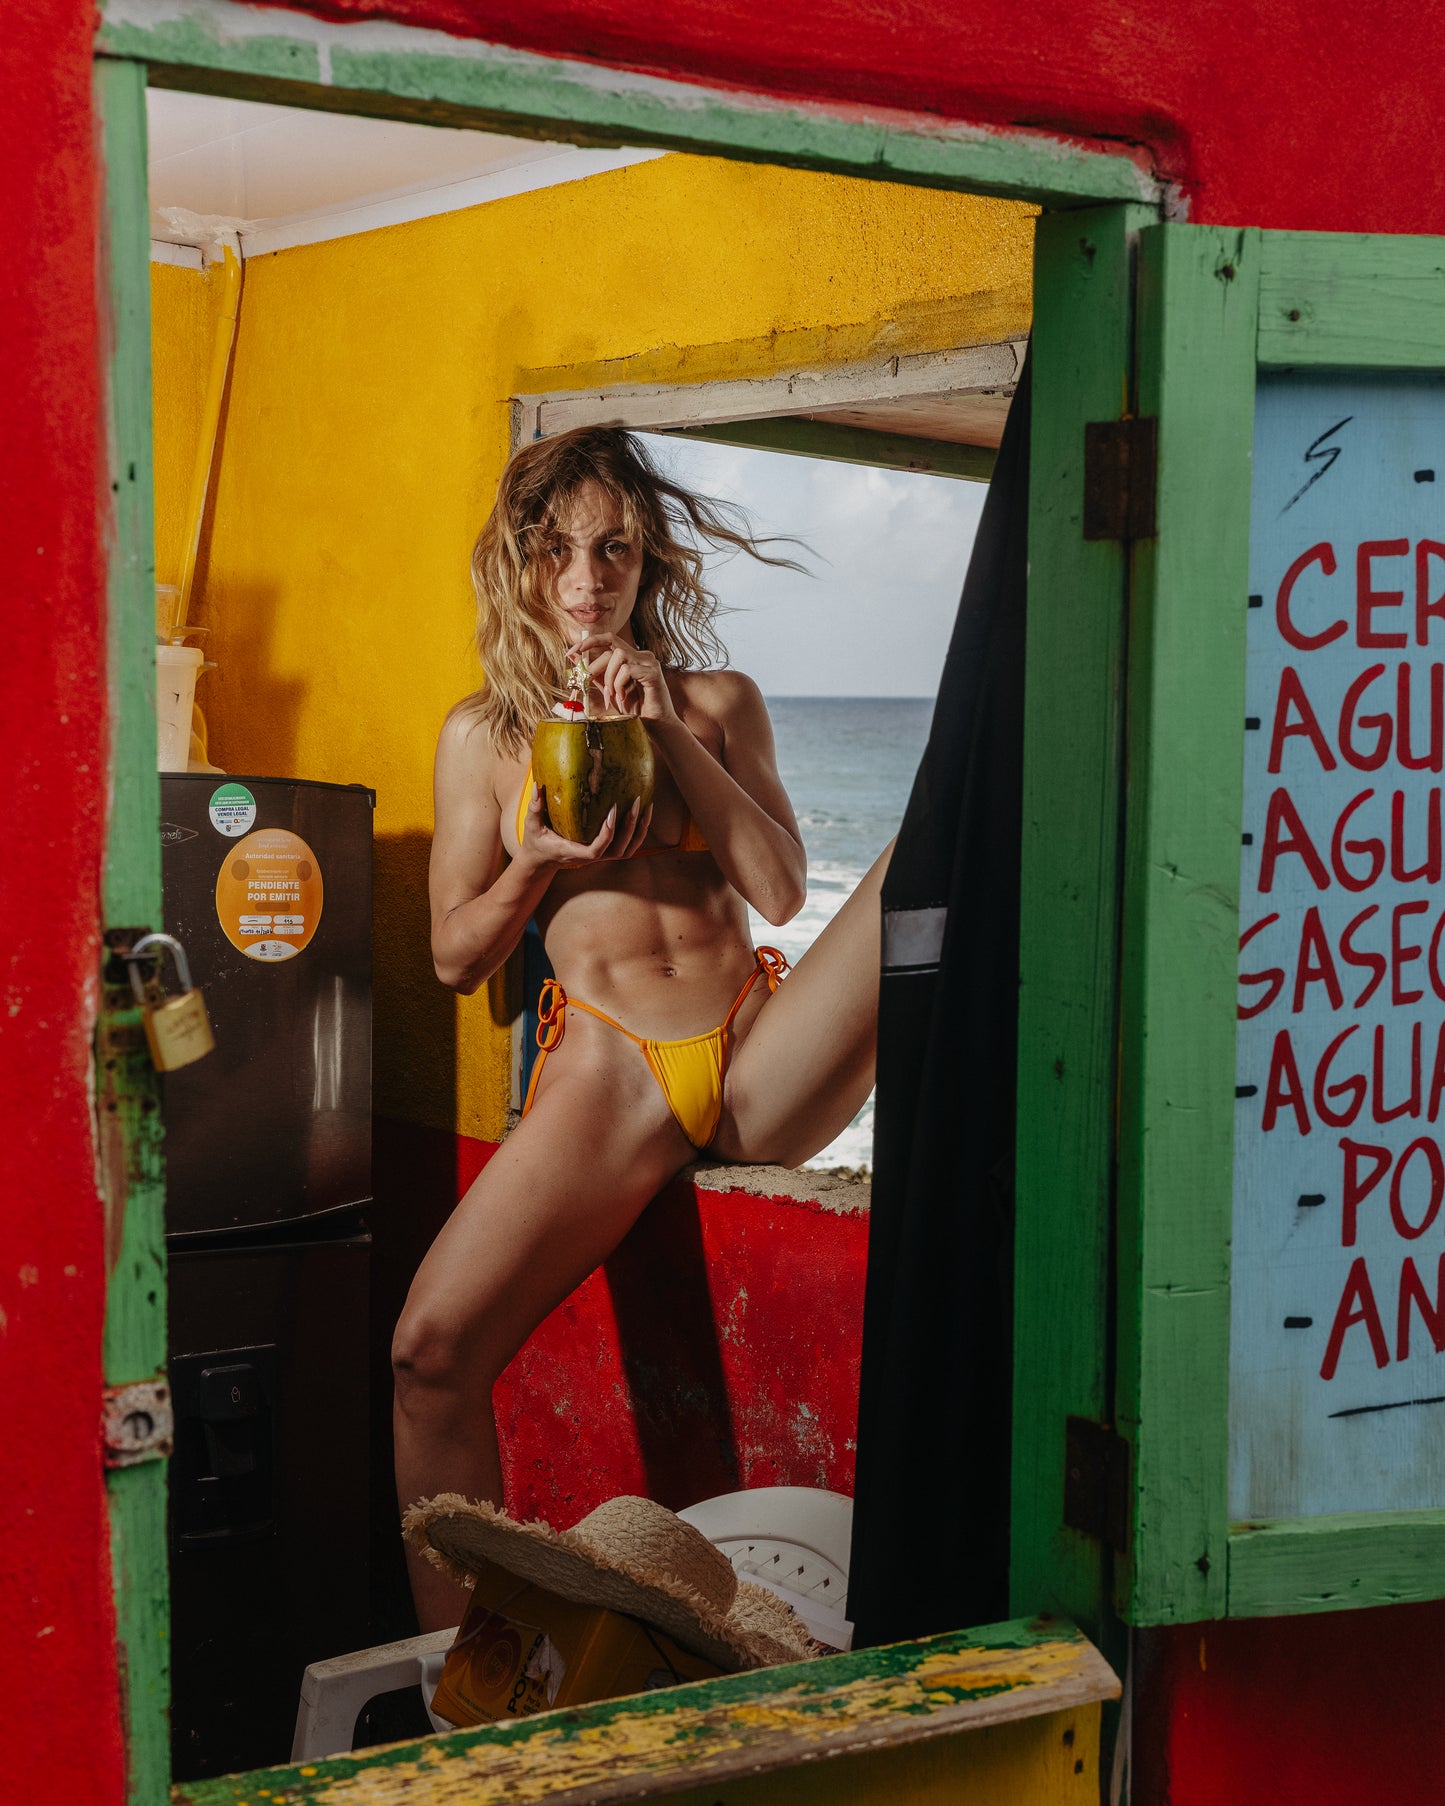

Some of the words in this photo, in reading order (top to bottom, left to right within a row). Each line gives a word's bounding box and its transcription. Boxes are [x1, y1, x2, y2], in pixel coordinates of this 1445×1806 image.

[1267, 661, 1445, 774] AGU
[1257, 786, 1443, 894] AGU
[245, 852, 274, 860] Autoridad
[249, 881, 300, 889] PENDIENTE
[248, 892, 266, 900] POR
[270, 892, 300, 900] EMITIR
